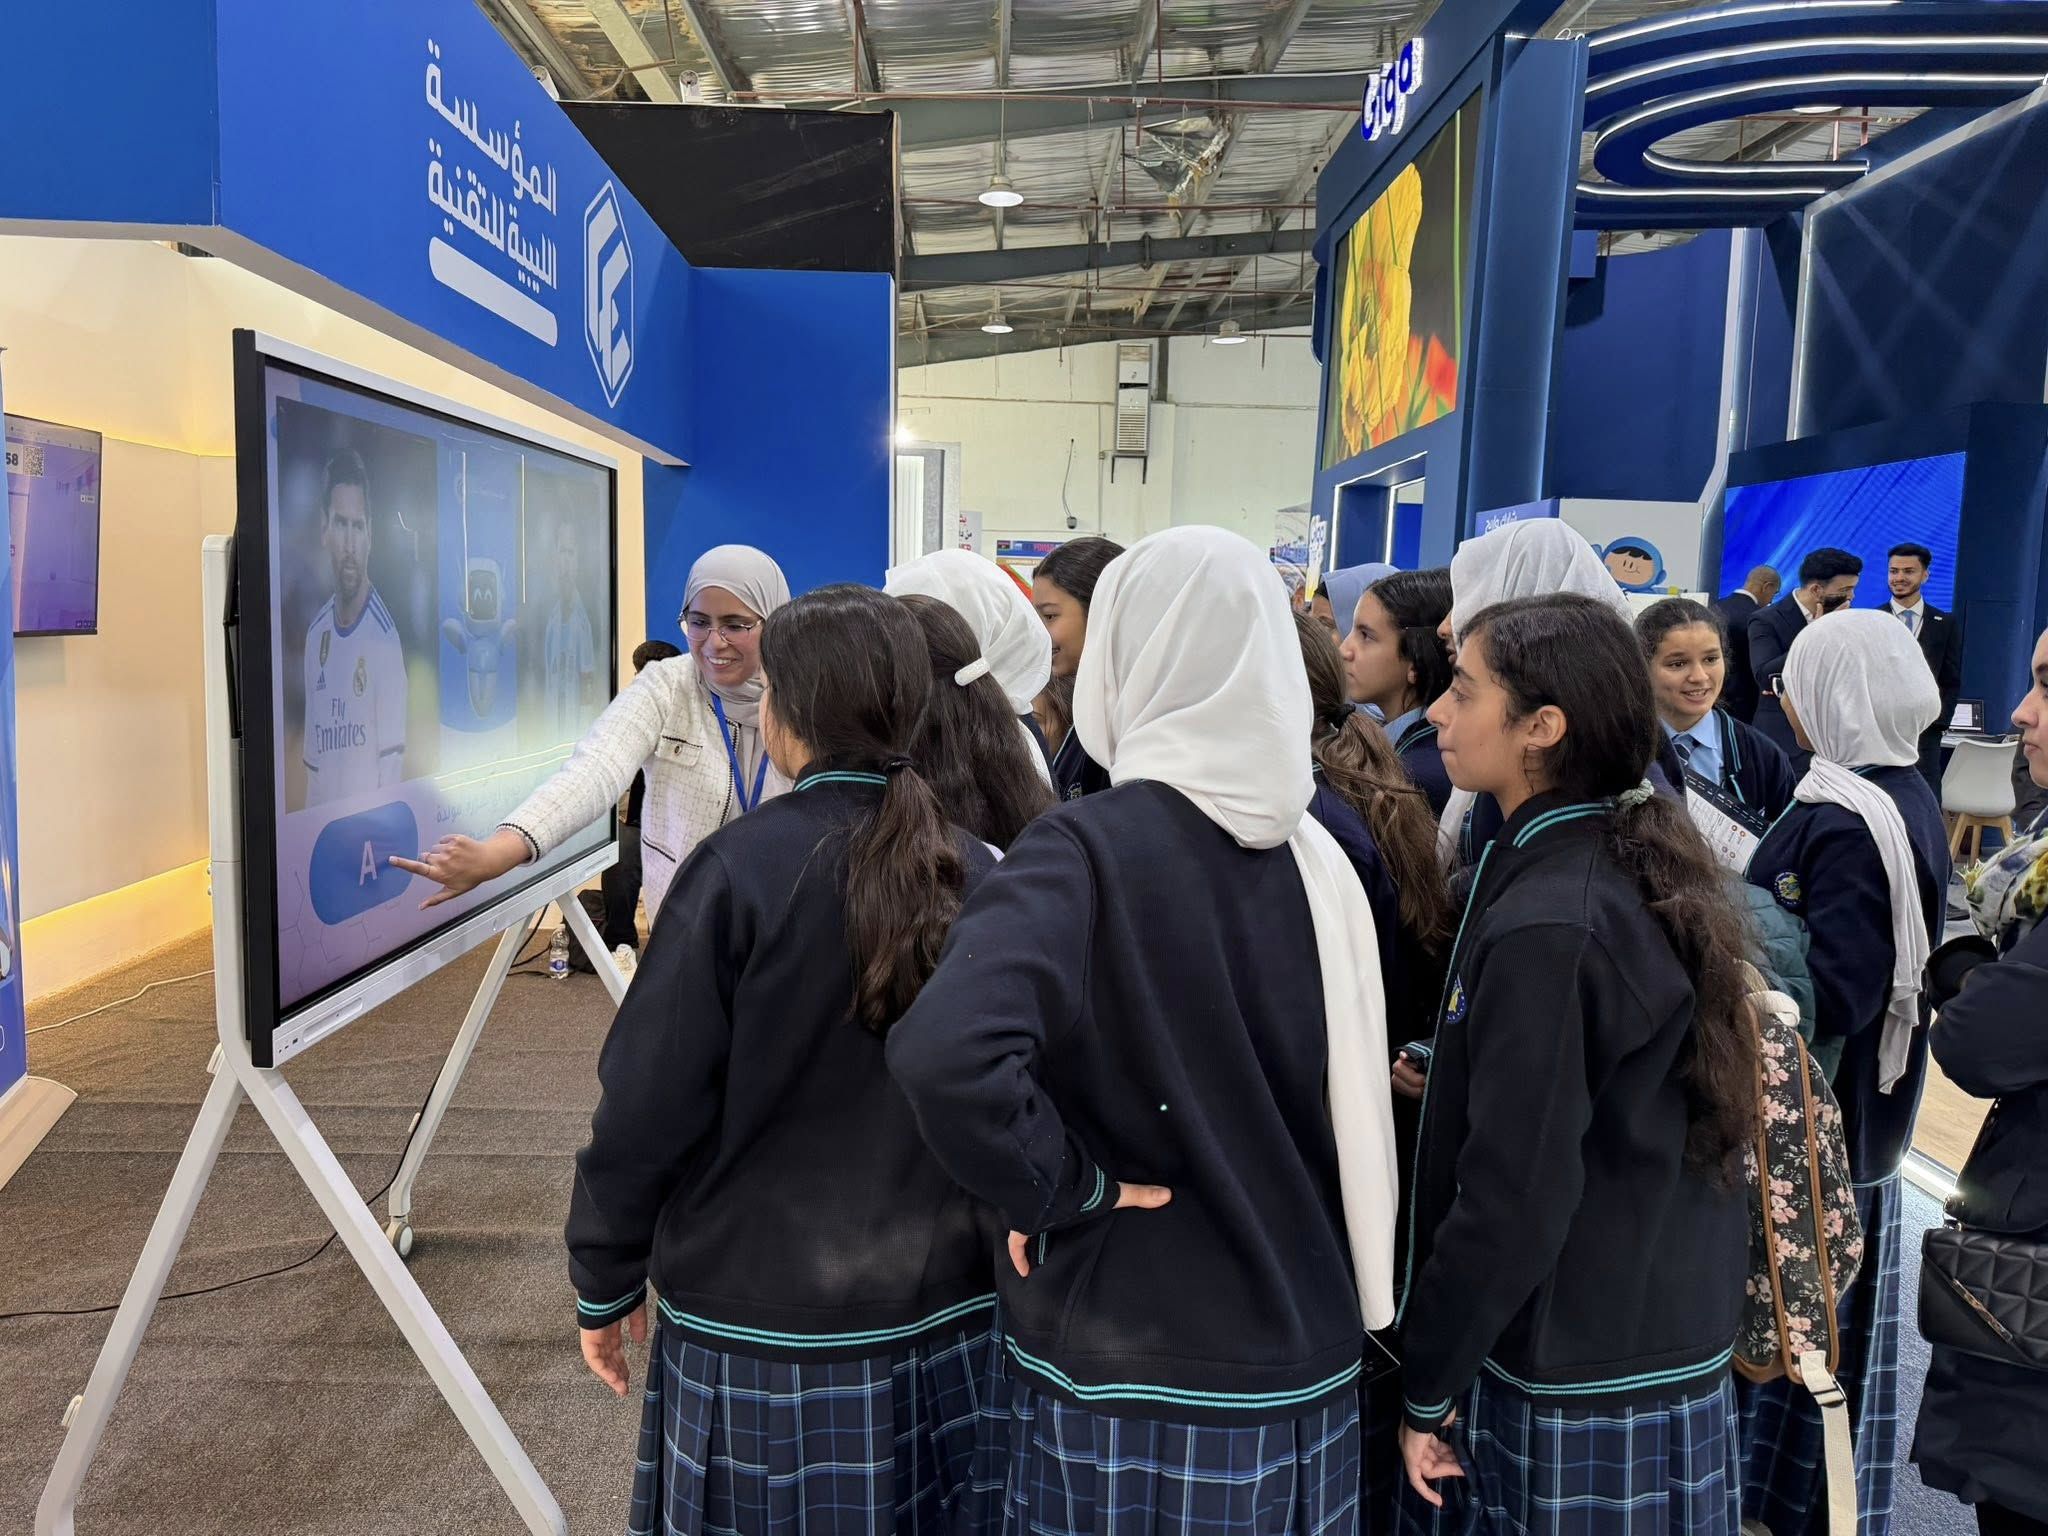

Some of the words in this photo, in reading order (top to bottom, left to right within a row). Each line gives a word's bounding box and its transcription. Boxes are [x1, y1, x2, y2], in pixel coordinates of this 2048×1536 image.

[425, 38, 557, 217] المؤسسة
[427, 138, 505, 253] للتقنية
[507, 203, 557, 294] الليبية
[315, 720, 366, 754] Emirates
[331, 698, 346, 721] Fly
[358, 840, 378, 886] A
